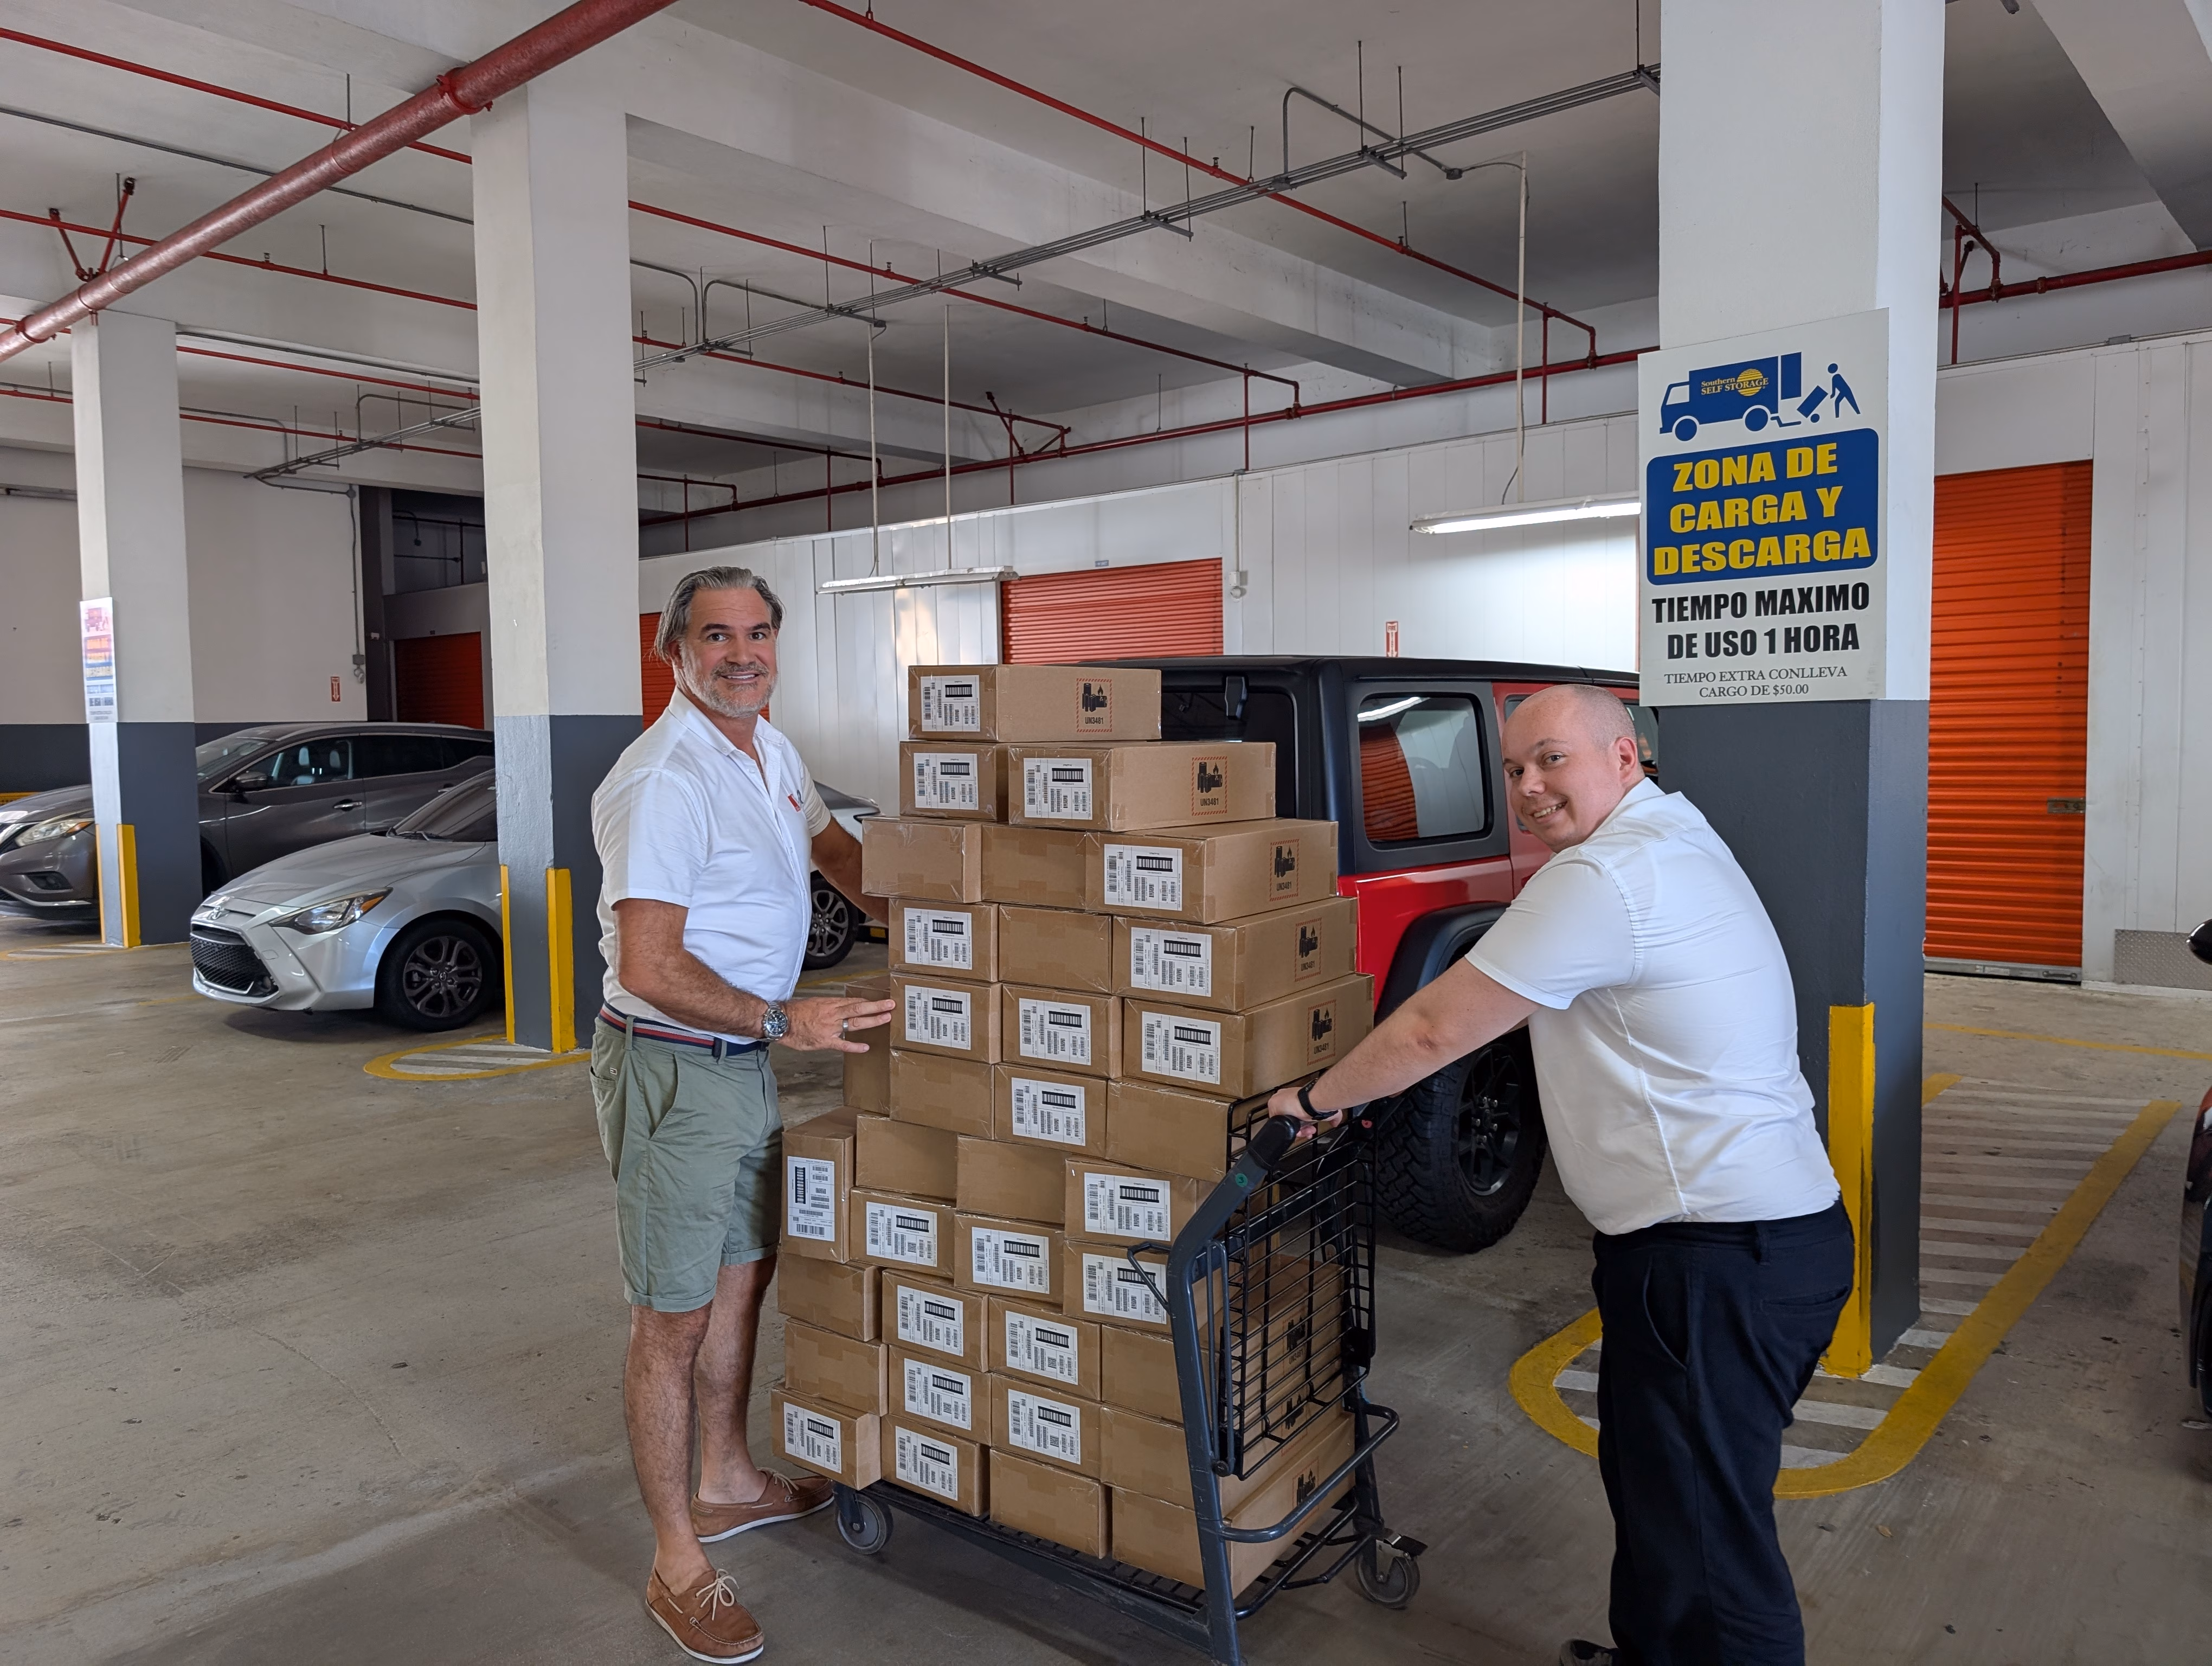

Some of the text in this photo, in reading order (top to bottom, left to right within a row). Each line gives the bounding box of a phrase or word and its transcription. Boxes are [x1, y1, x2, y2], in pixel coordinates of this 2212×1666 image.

[1701, 377, 1735, 387] Southern
[1701, 377, 1769, 395] SELF STORAGE
[1673, 443, 1838, 493] ZONA DE
[1670, 485, 1843, 534] CARGA Y
[1654, 527, 1872, 576] DESCARGA
[1652, 582, 1869, 624] TIEMPO MAXIMO
[1667, 623, 1860, 660] DE USO 1 HORA
[1664, 666, 1848, 684] TIEMPO EXTRA CONLLEVA
[1699, 684, 1809, 698] CARGO DE $50.00
[1200, 798, 1219, 806] UN3481
[1276, 881, 1292, 891] UN3481
